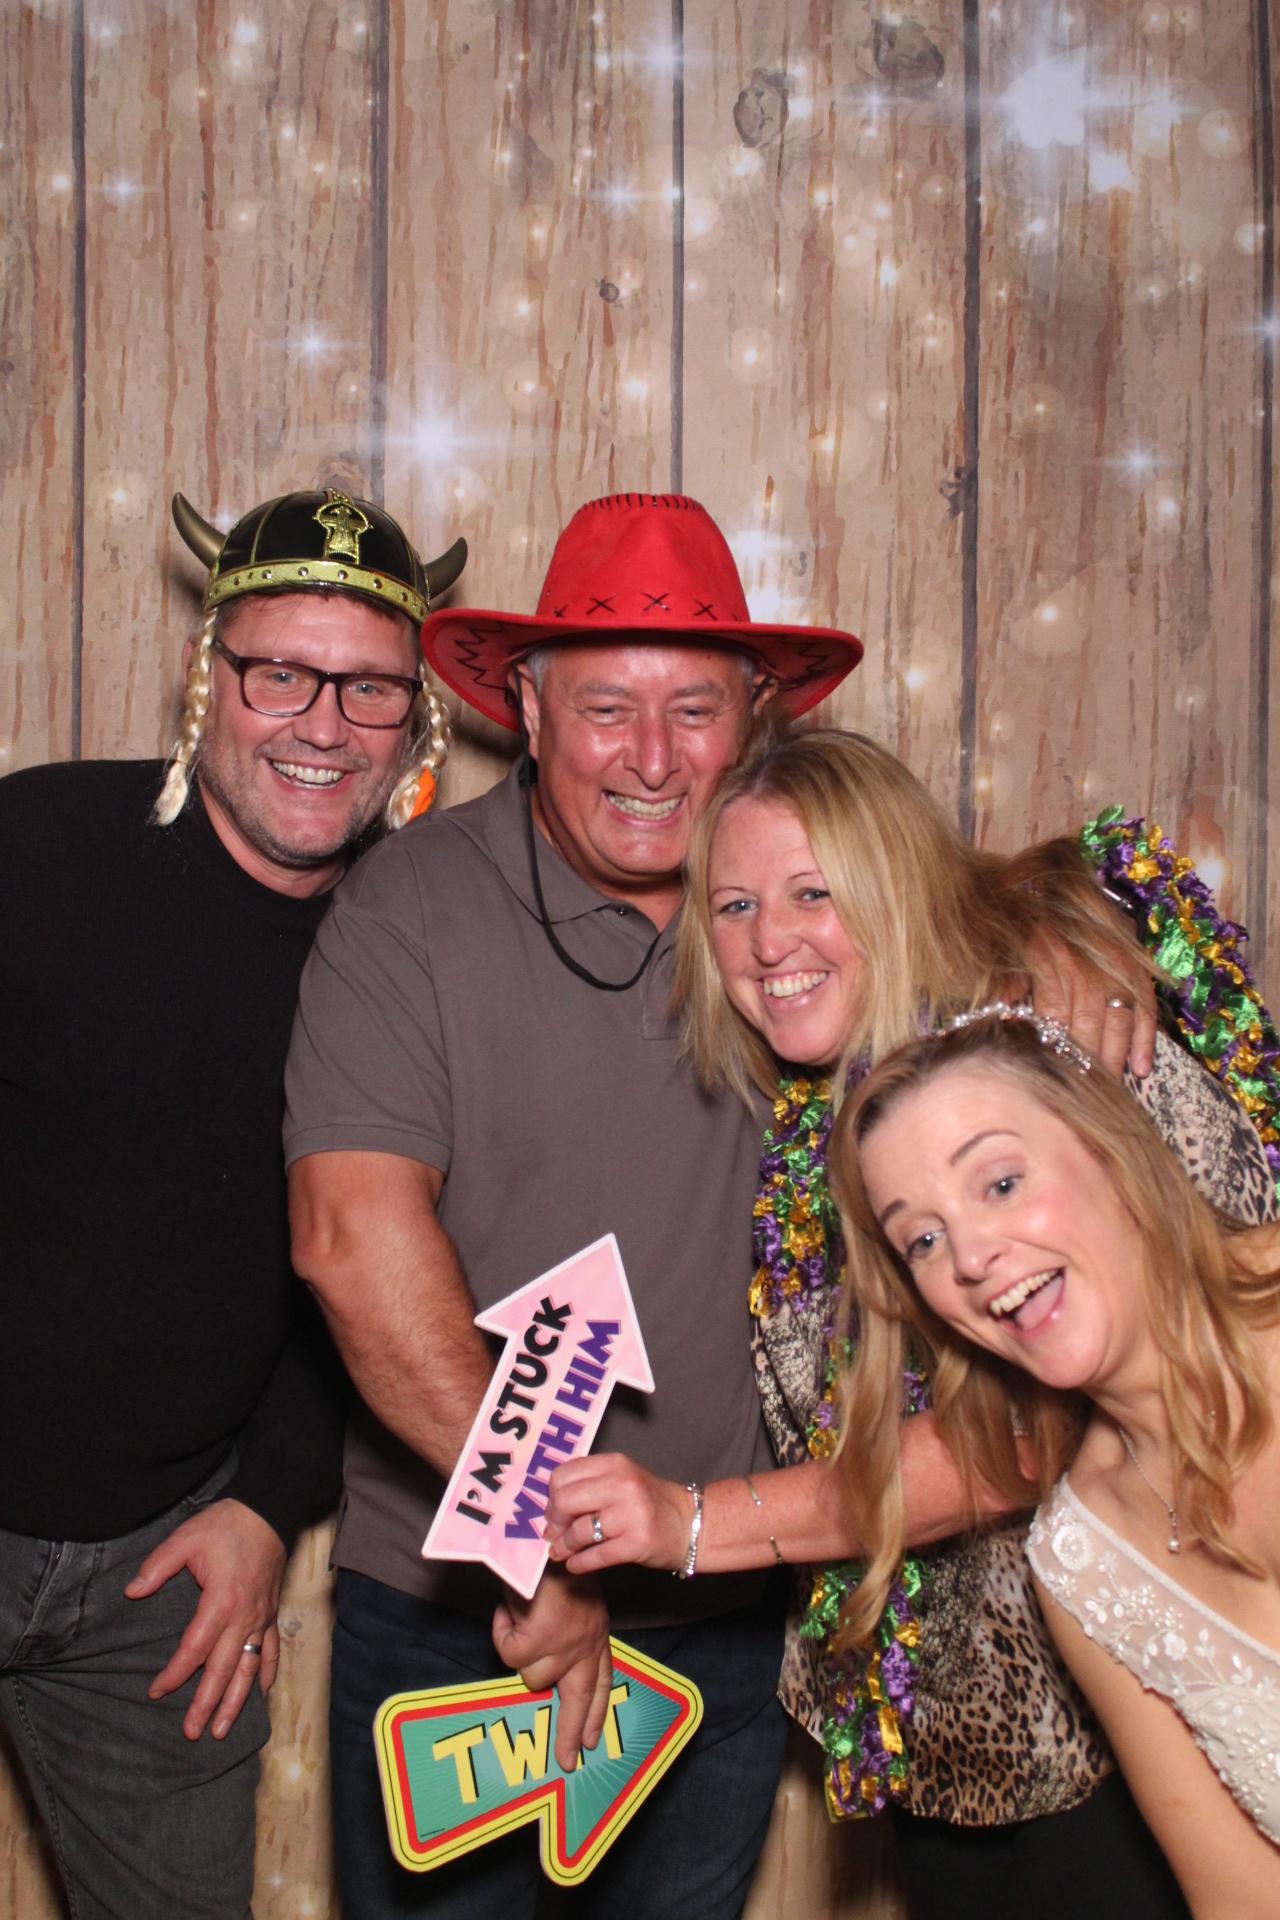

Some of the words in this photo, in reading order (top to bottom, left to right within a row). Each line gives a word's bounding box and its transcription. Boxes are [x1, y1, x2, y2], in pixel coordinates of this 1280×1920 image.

[456, 1451, 515, 1526] I'M
[490, 1296, 573, 1440] STUCK
[504, 1410, 586, 1540] WITH
[555, 1319, 622, 1412] HIM
[432, 1683, 630, 1804] TWT
